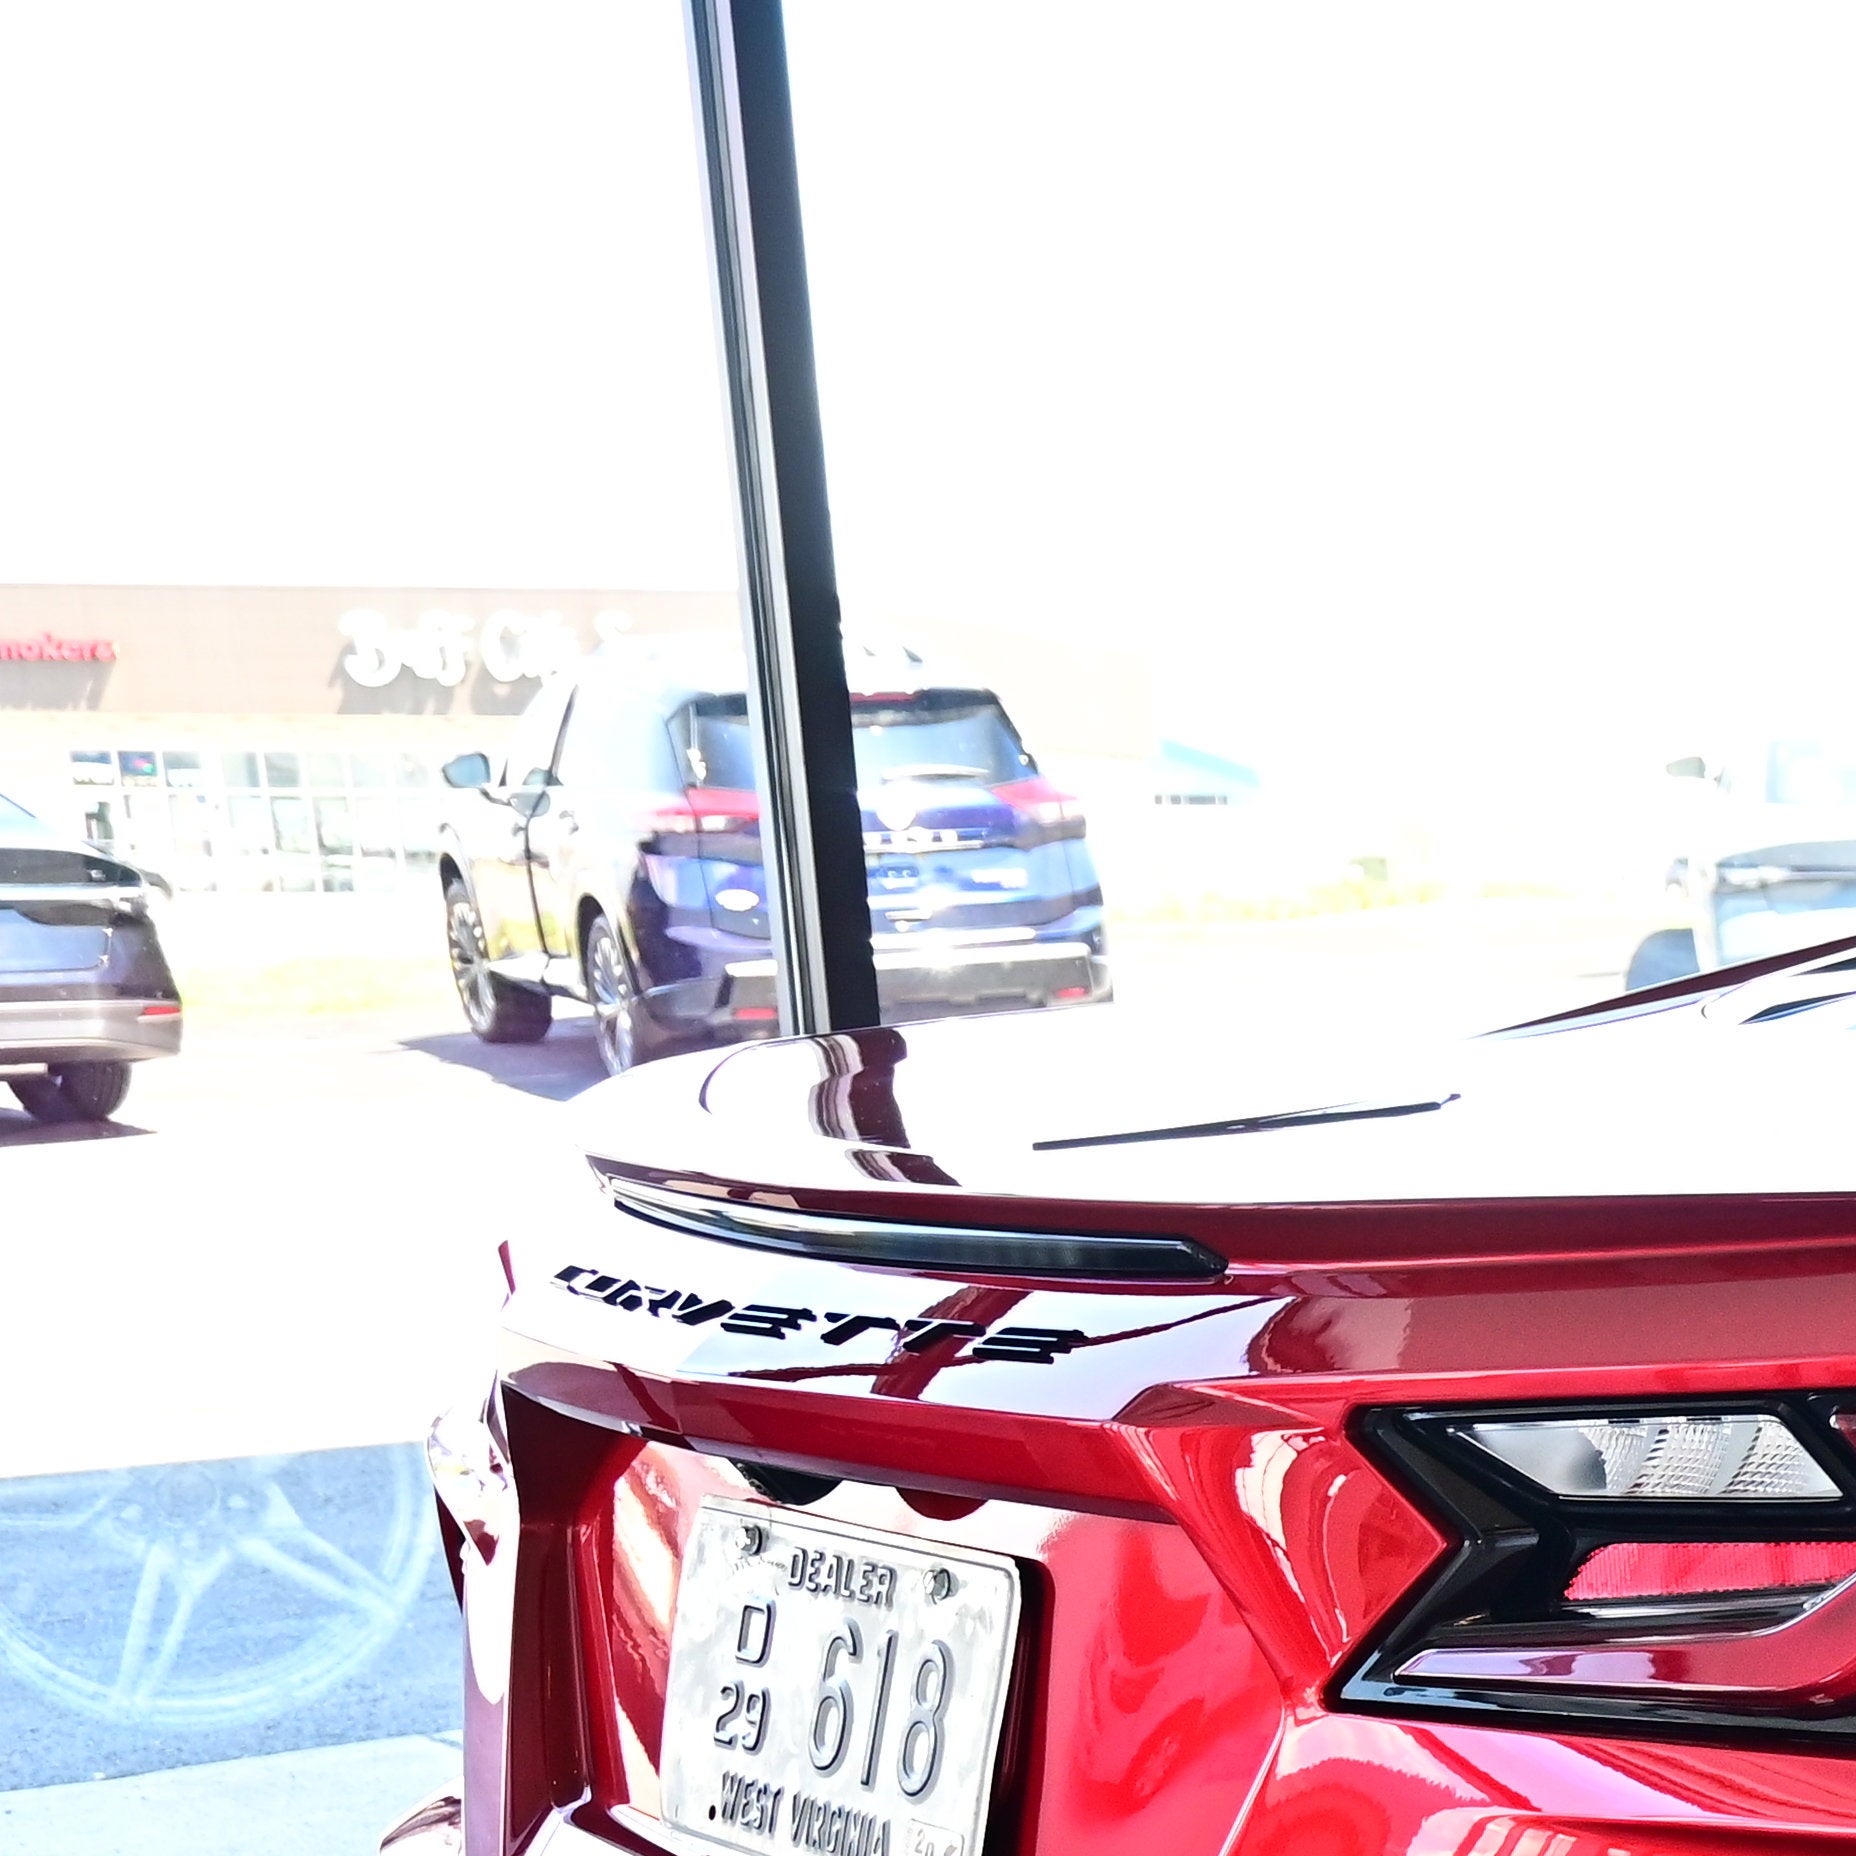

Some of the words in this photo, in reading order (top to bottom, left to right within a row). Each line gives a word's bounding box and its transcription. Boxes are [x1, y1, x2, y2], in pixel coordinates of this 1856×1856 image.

[550, 1264, 1090, 1365] CORVETTE
[788, 1547, 898, 1611] DEALER
[736, 1600, 776, 1667] D
[714, 1679, 772, 1754] 29
[809, 1617, 956, 1804] 618
[721, 1770, 784, 1838] WEST
